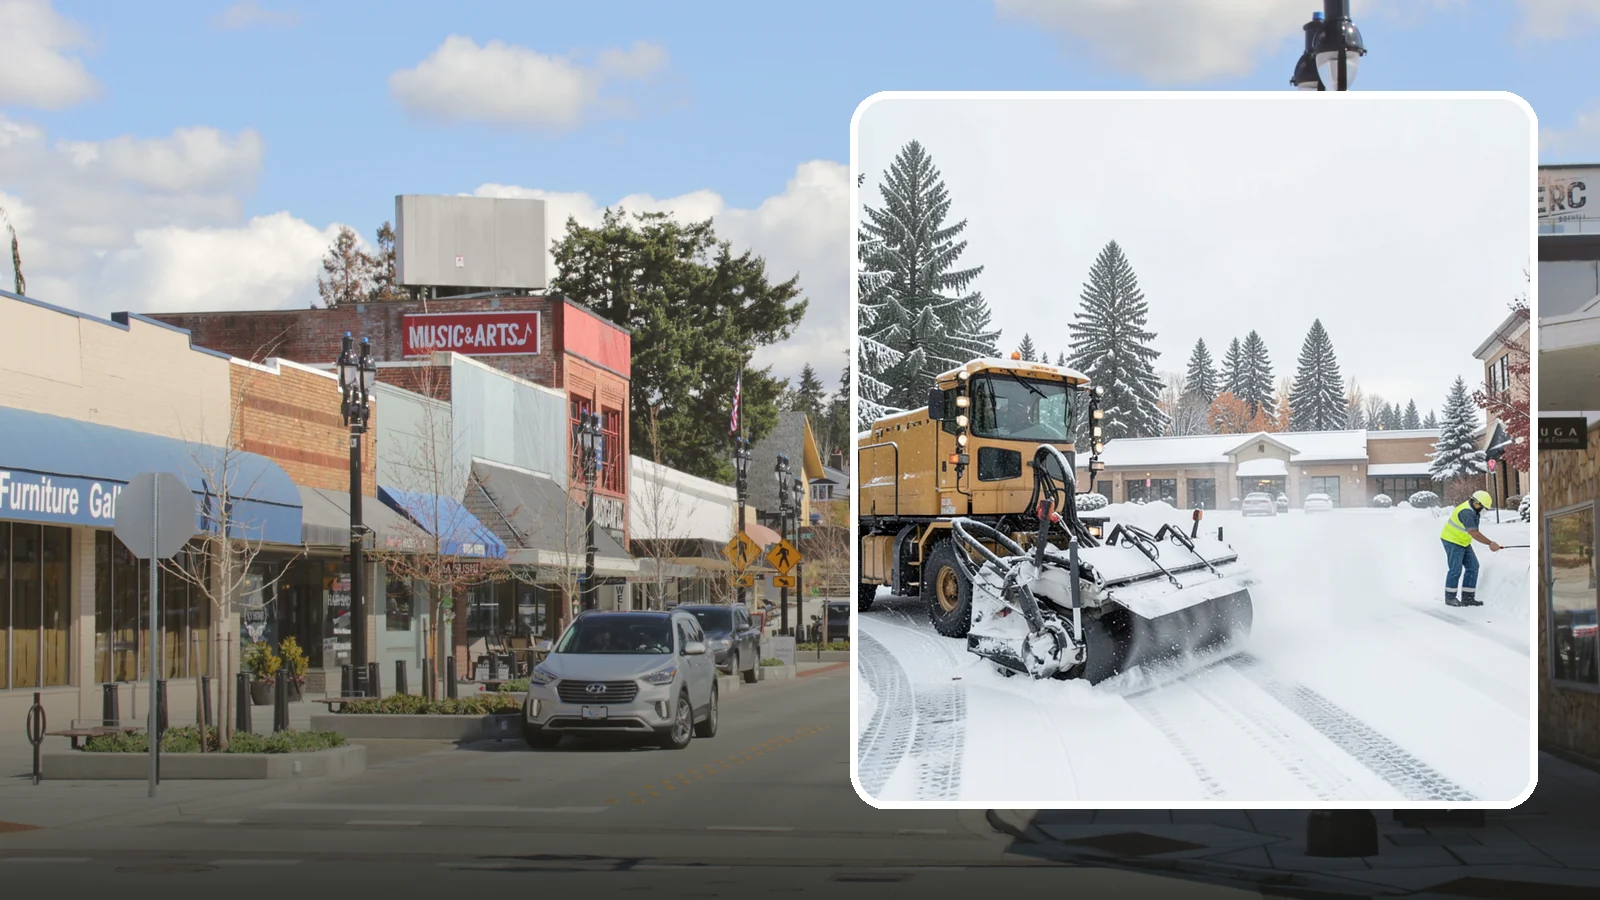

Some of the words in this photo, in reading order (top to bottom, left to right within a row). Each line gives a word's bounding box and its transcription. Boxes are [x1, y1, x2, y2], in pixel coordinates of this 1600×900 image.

[408, 322, 520, 349] MUSIC&ARTS
[1540, 427, 1577, 437] UGA
[0, 471, 79, 515] Furniture
